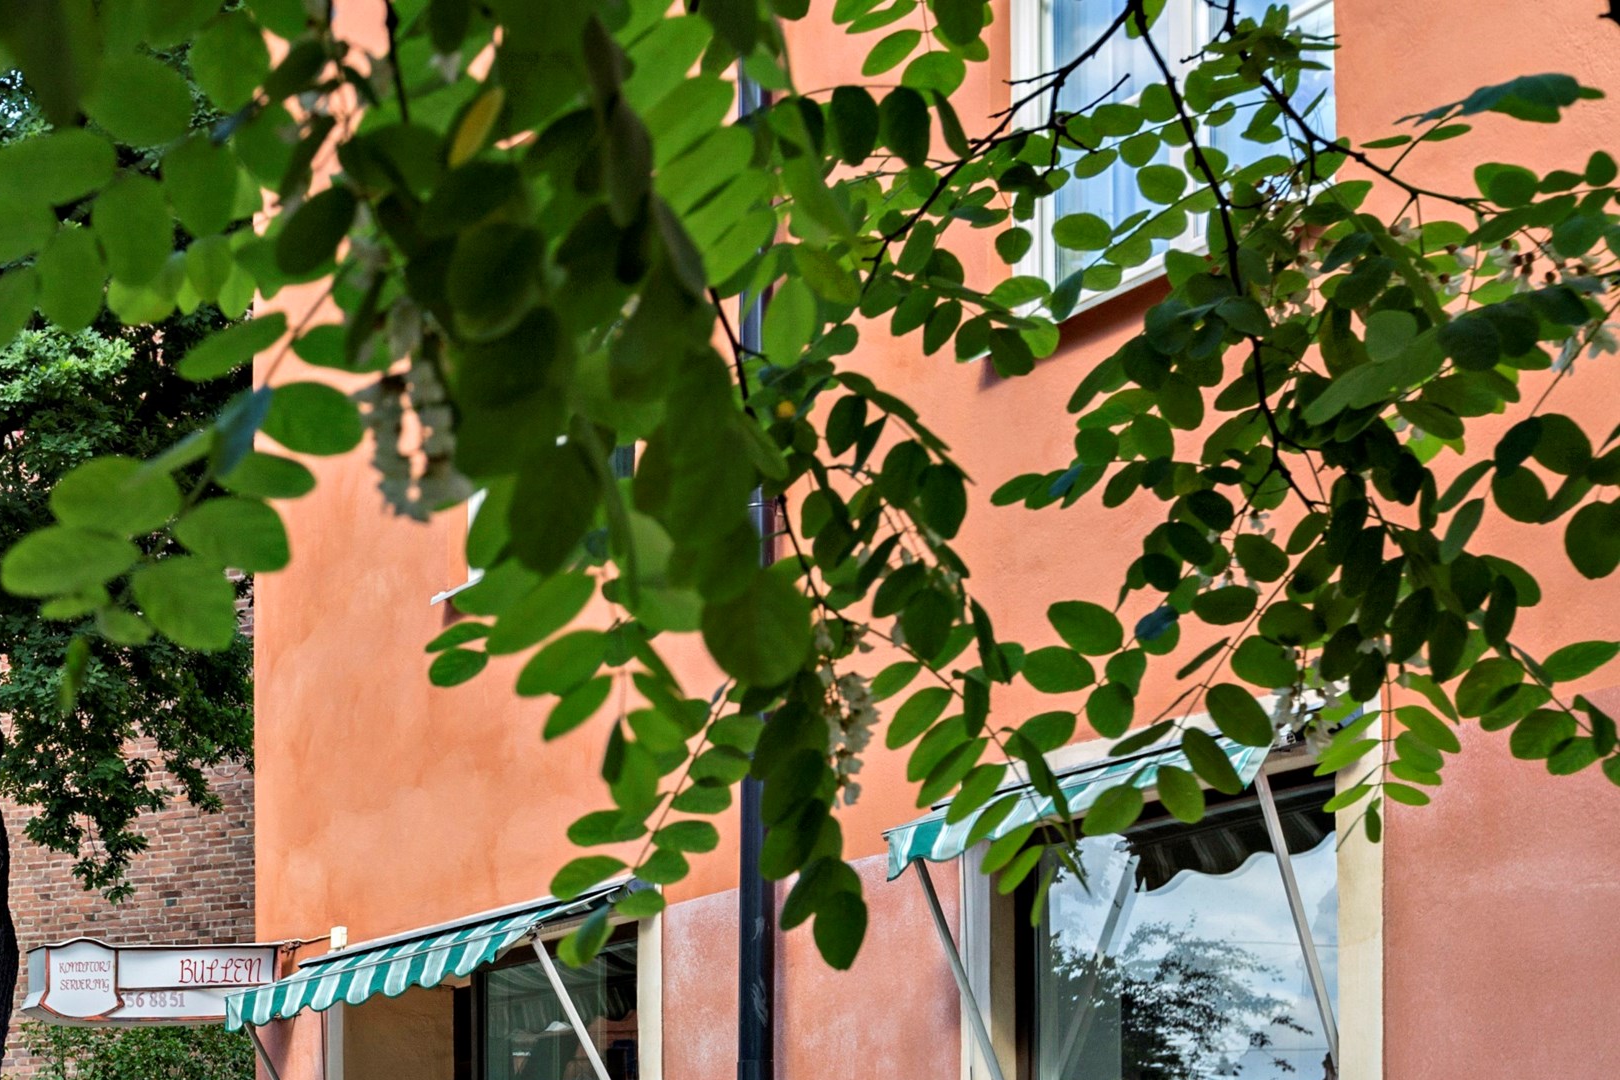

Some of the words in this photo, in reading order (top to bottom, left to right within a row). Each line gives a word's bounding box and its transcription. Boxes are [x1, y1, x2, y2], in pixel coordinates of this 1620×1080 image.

[59, 961, 111, 973] KONDITORI
[179, 958, 261, 984] BULLEN
[60, 979, 109, 992] SERVERING
